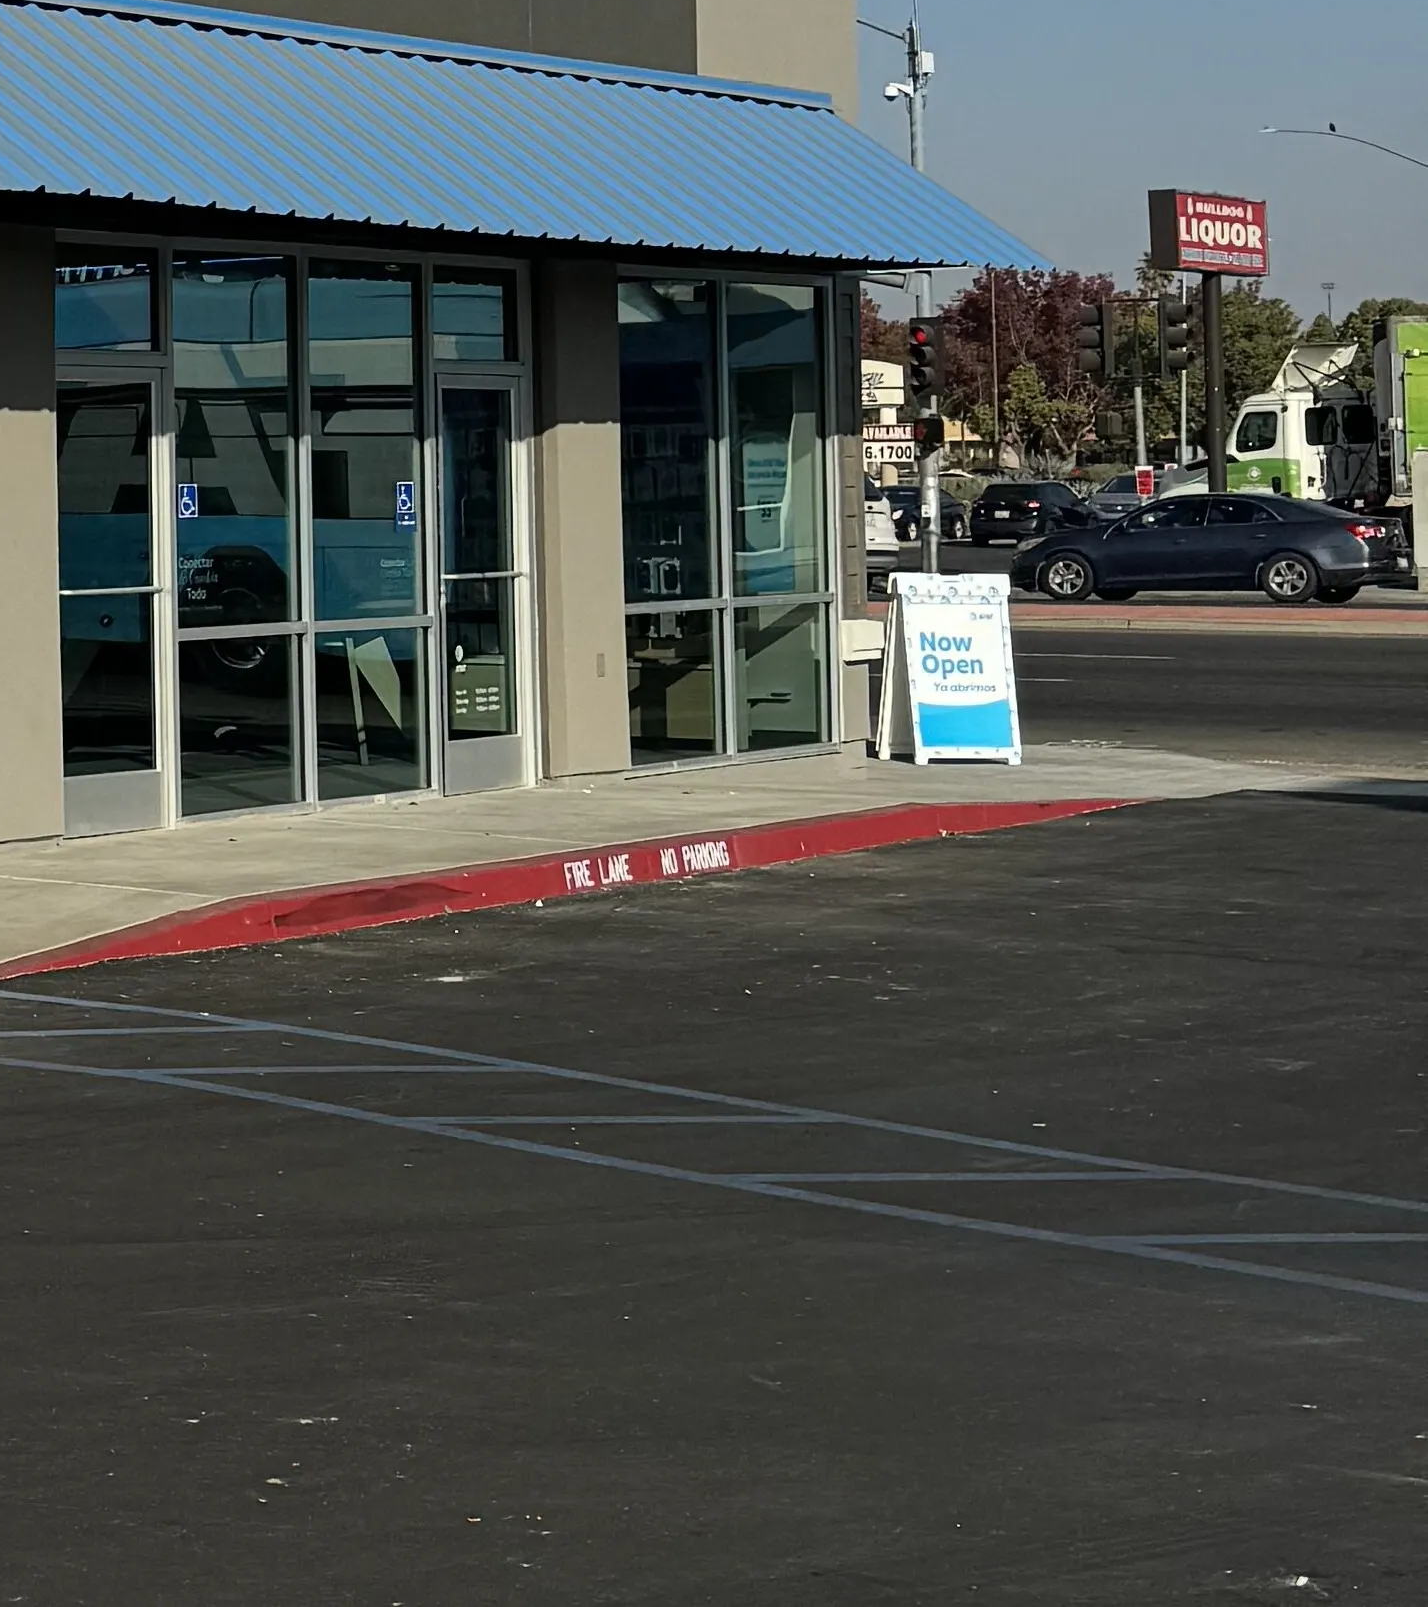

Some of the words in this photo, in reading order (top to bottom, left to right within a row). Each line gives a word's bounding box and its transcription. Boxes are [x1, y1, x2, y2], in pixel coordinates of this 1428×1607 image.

[1179, 216, 1263, 249] LIQUOR
[863, 426, 911, 440] AVAILABLE
[919, 631, 973, 652] Now
[921, 654, 984, 680] Open
[934, 681, 948, 692] Ya
[950, 681, 996, 692] abrimos
[563, 859, 595, 890] FIRE
[597, 853, 633, 884] LANE
[659, 847, 679, 876] NO
[681, 840, 730, 872] PARKING
